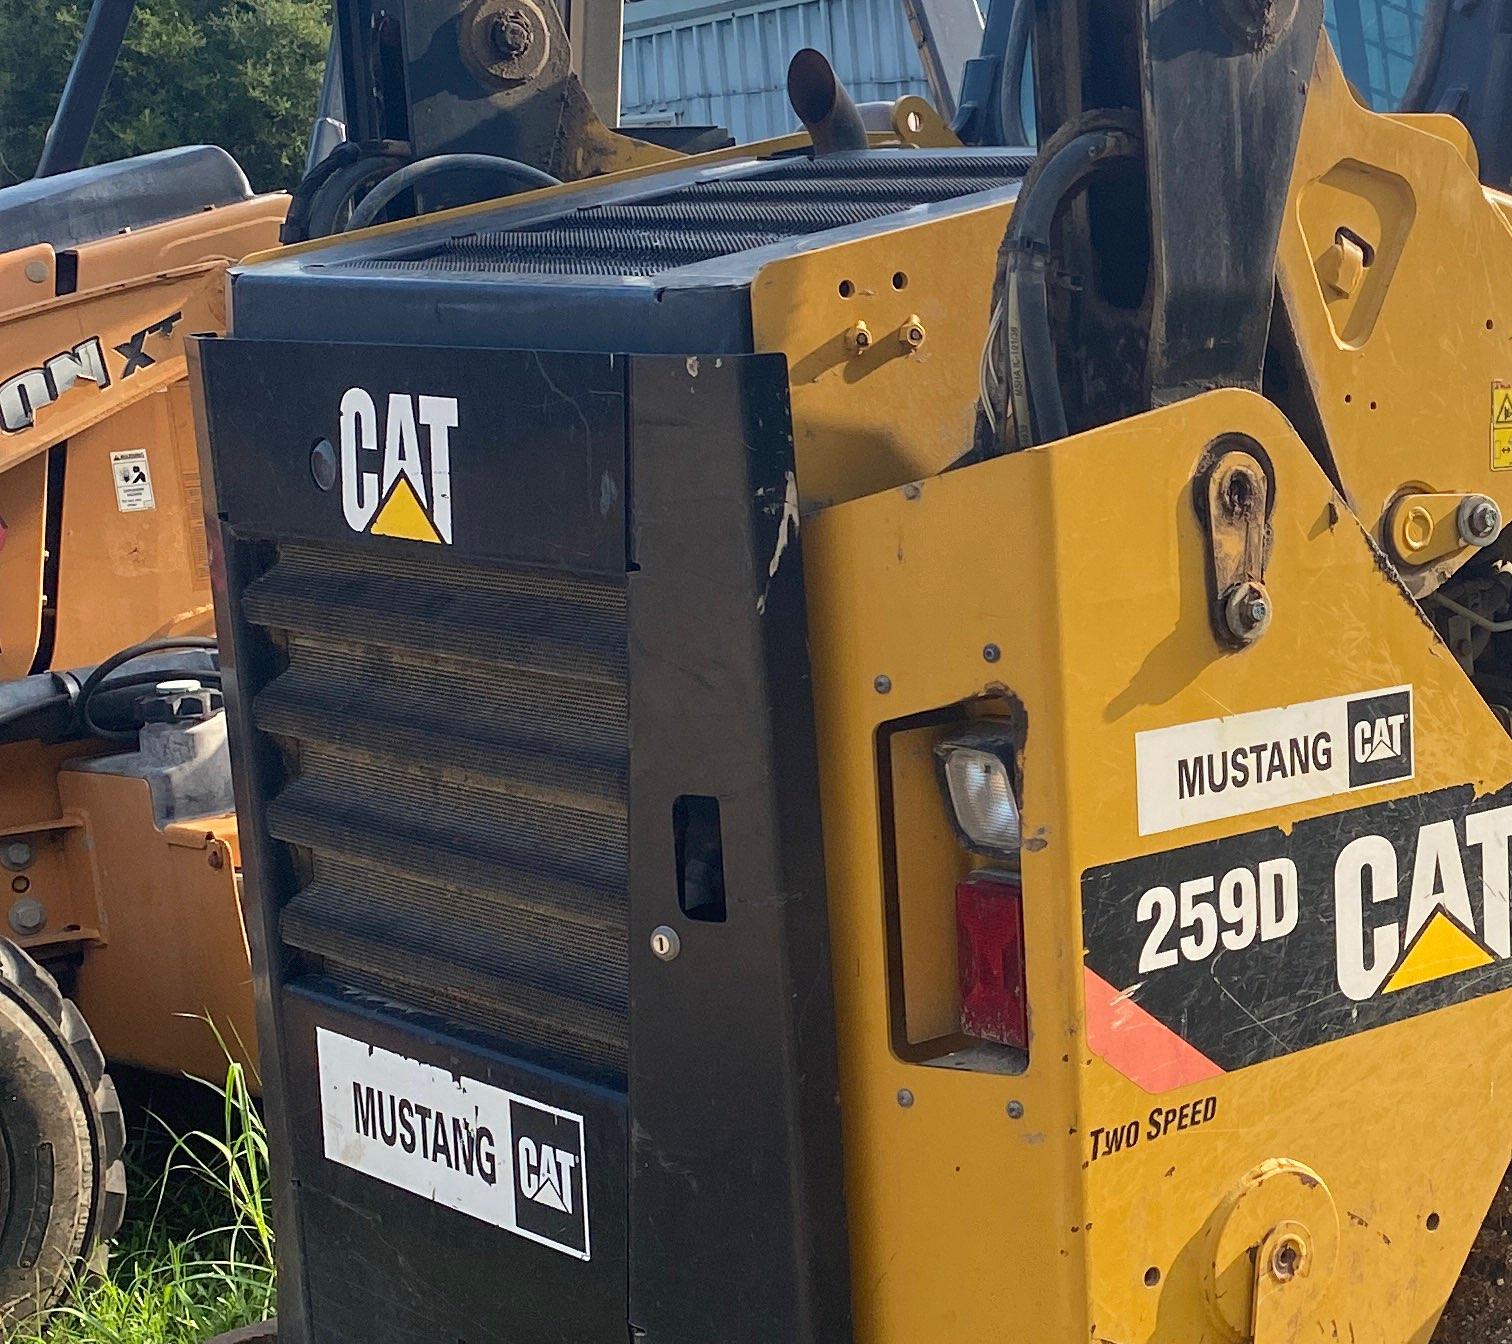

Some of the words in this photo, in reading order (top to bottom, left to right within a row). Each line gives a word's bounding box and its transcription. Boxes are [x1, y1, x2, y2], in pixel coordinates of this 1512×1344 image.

[340, 387, 458, 544] CAT
[1178, 730, 1333, 800] MUSTANG
[1354, 713, 1406, 764] CAT
[1135, 856, 1300, 975] 259D
[353, 1080, 496, 1187] MUSTANG
[518, 1136, 577, 1214] CAT
[1089, 1120, 1140, 1161] TWO
[1146, 1096, 1217, 1141] SPEED
